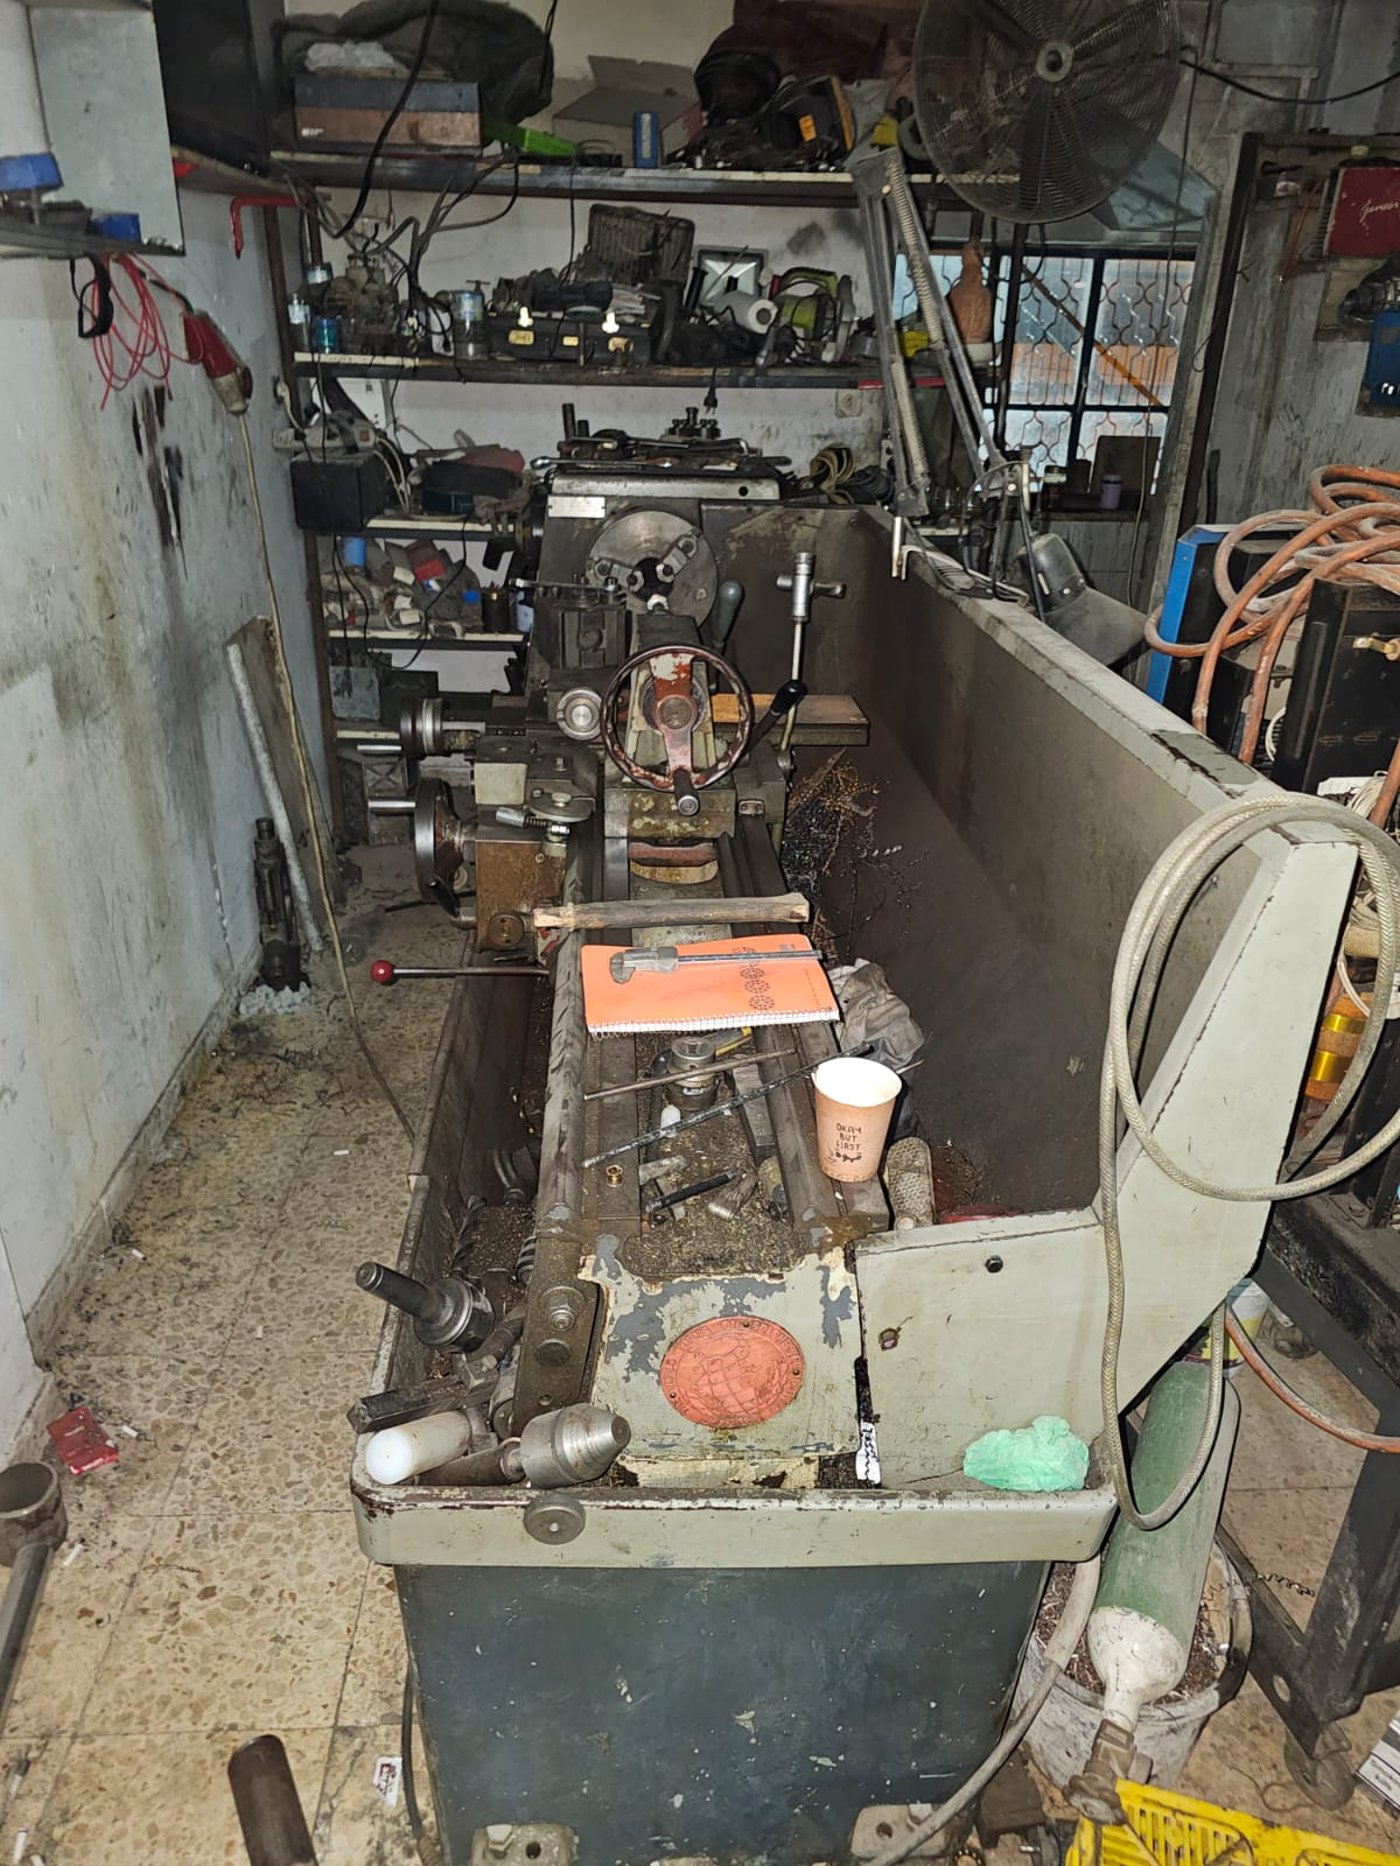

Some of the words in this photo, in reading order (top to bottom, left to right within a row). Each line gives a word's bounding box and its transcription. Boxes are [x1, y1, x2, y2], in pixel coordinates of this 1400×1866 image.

[836, 1123, 862, 1134] OKAY
[839, 1132, 857, 1141] BUT
[836, 1141, 860, 1150] FIRST
